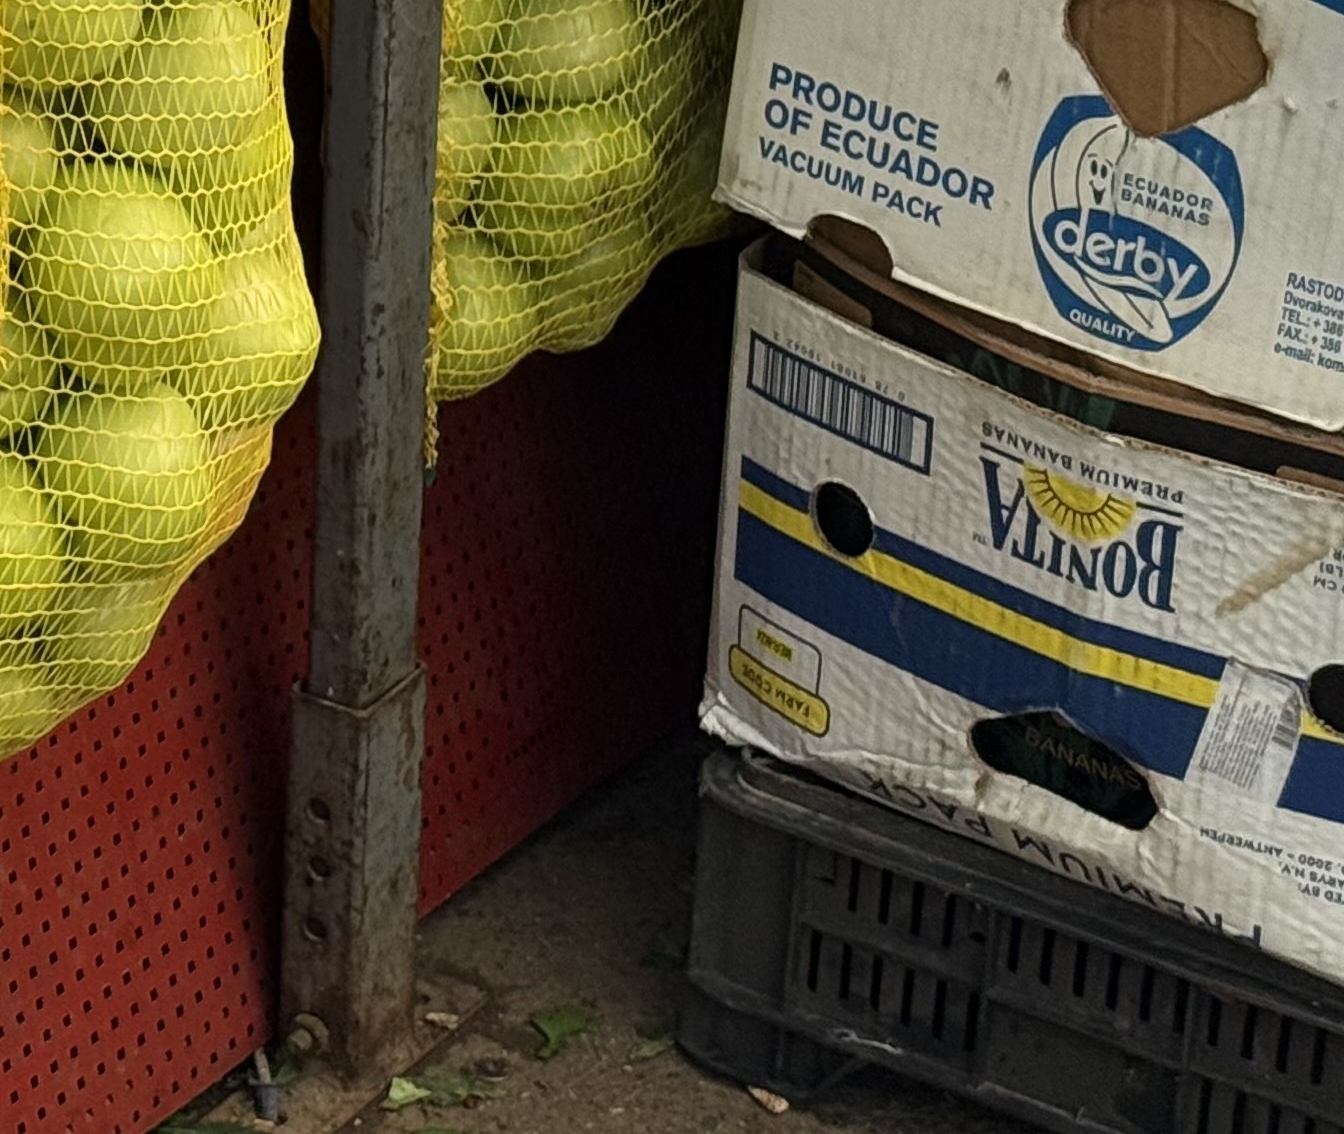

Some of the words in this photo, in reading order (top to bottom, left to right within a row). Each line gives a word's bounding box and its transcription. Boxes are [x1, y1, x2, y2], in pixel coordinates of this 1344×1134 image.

[768, 61, 940, 154] PRODUCE
[758, 136, 866, 199] VACUUM
[872, 181, 944, 228] PACK
[764, 98, 816, 140] OF
[819, 119, 997, 211] ECUADOR
[1120, 188, 1211, 227] BANANAS
[1122, 172, 1214, 211] ECUADOR
[1054, 206, 1199, 302] derby
[1068, 307, 1136, 343] QUALITY
[981, 420, 1073, 471] BANANAS
[1079, 461, 1185, 505] PREMIUM
[978, 455, 1185, 615] BONITA
[1024, 725, 1142, 791] BANANAS
[861, 767, 994, 839] PACK
[1199, 826, 1284, 859] ANTWERPEN
